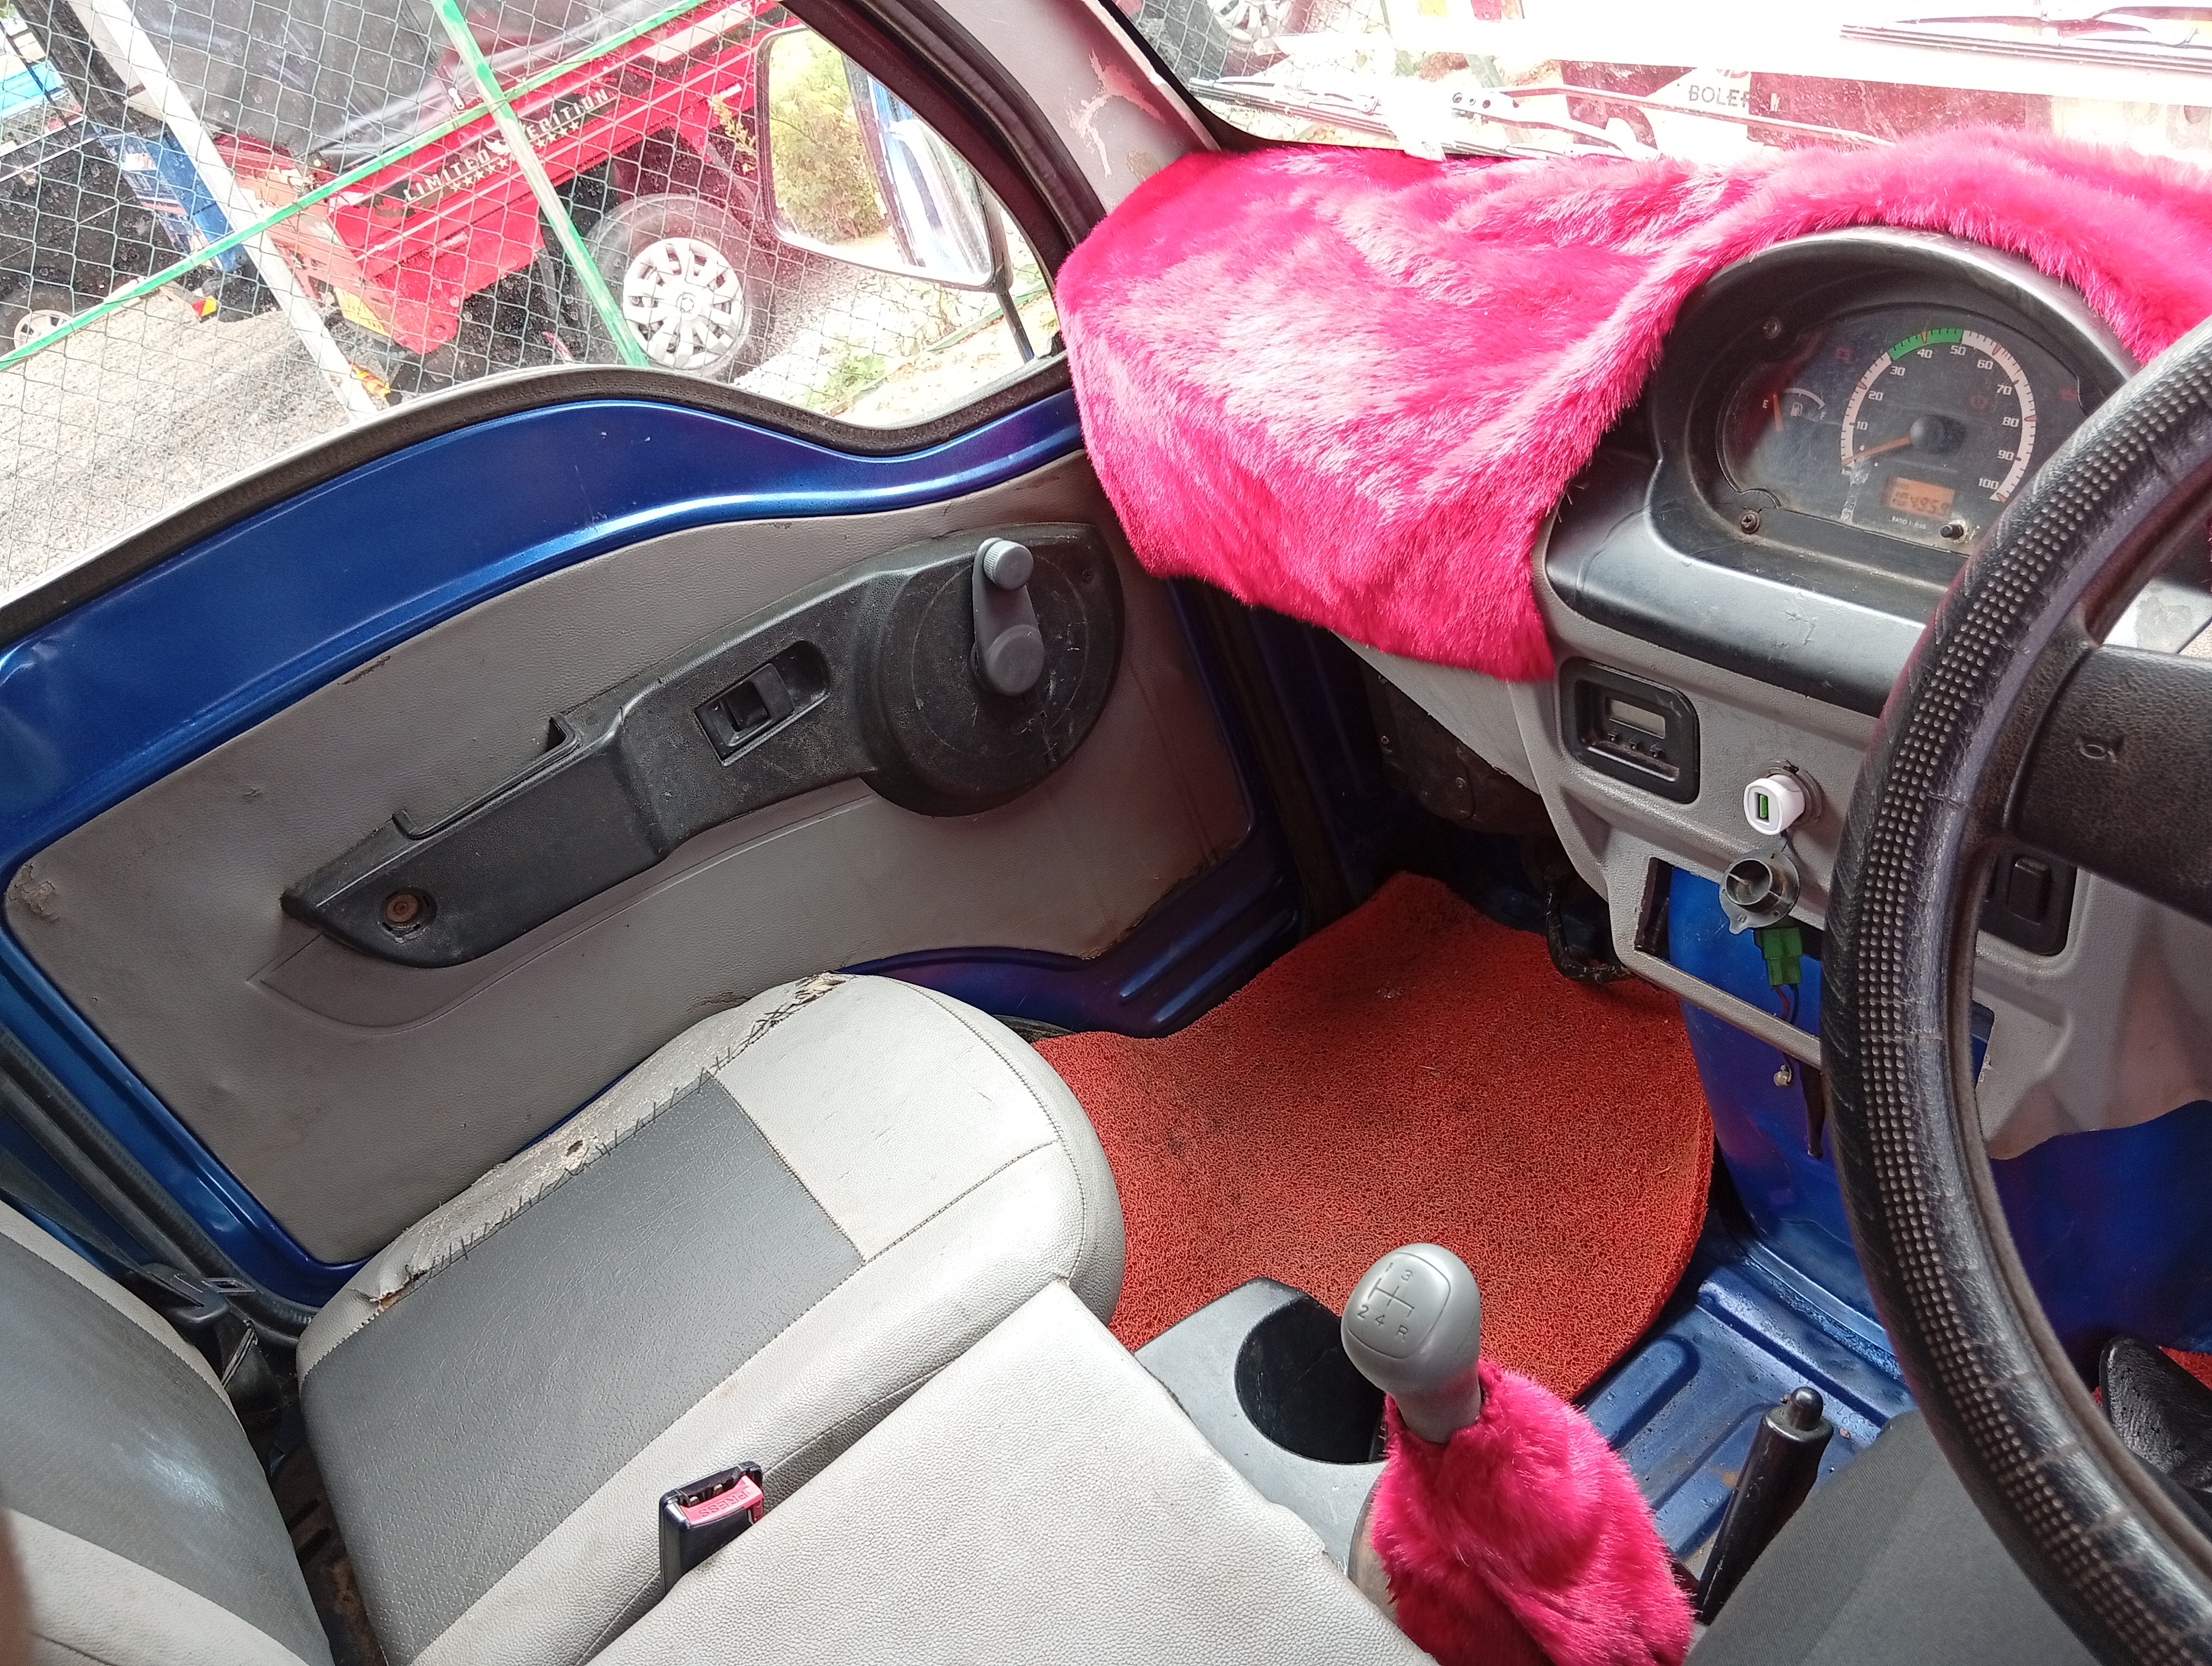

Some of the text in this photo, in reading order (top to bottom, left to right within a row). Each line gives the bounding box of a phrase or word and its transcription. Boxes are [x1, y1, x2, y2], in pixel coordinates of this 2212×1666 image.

[403, 88, 609, 201] LIMITED EDITION
[1917, 348, 1933, 358] 40
[1950, 345, 1966, 356] 50
[1977, 360, 1994, 370] 60
[1889, 366, 1906, 376] 30
[1997, 384, 2012, 395] 70
[1868, 390, 1883, 401] 20
[1763, 400, 1769, 408] E
[1820, 411, 1827, 420] F
[1857, 421, 1868, 430] 10
[2002, 416, 2019, 427] 80
[1997, 450, 2014, 460] 90
[1978, 478, 1999, 490] 100
[1385, 1262, 1393, 1272] 1
[1401, 1269, 1413, 1281] 3
[1357, 1305, 1408, 1341] 2 4 R
[698, 1490, 749, 1517] PRESS
